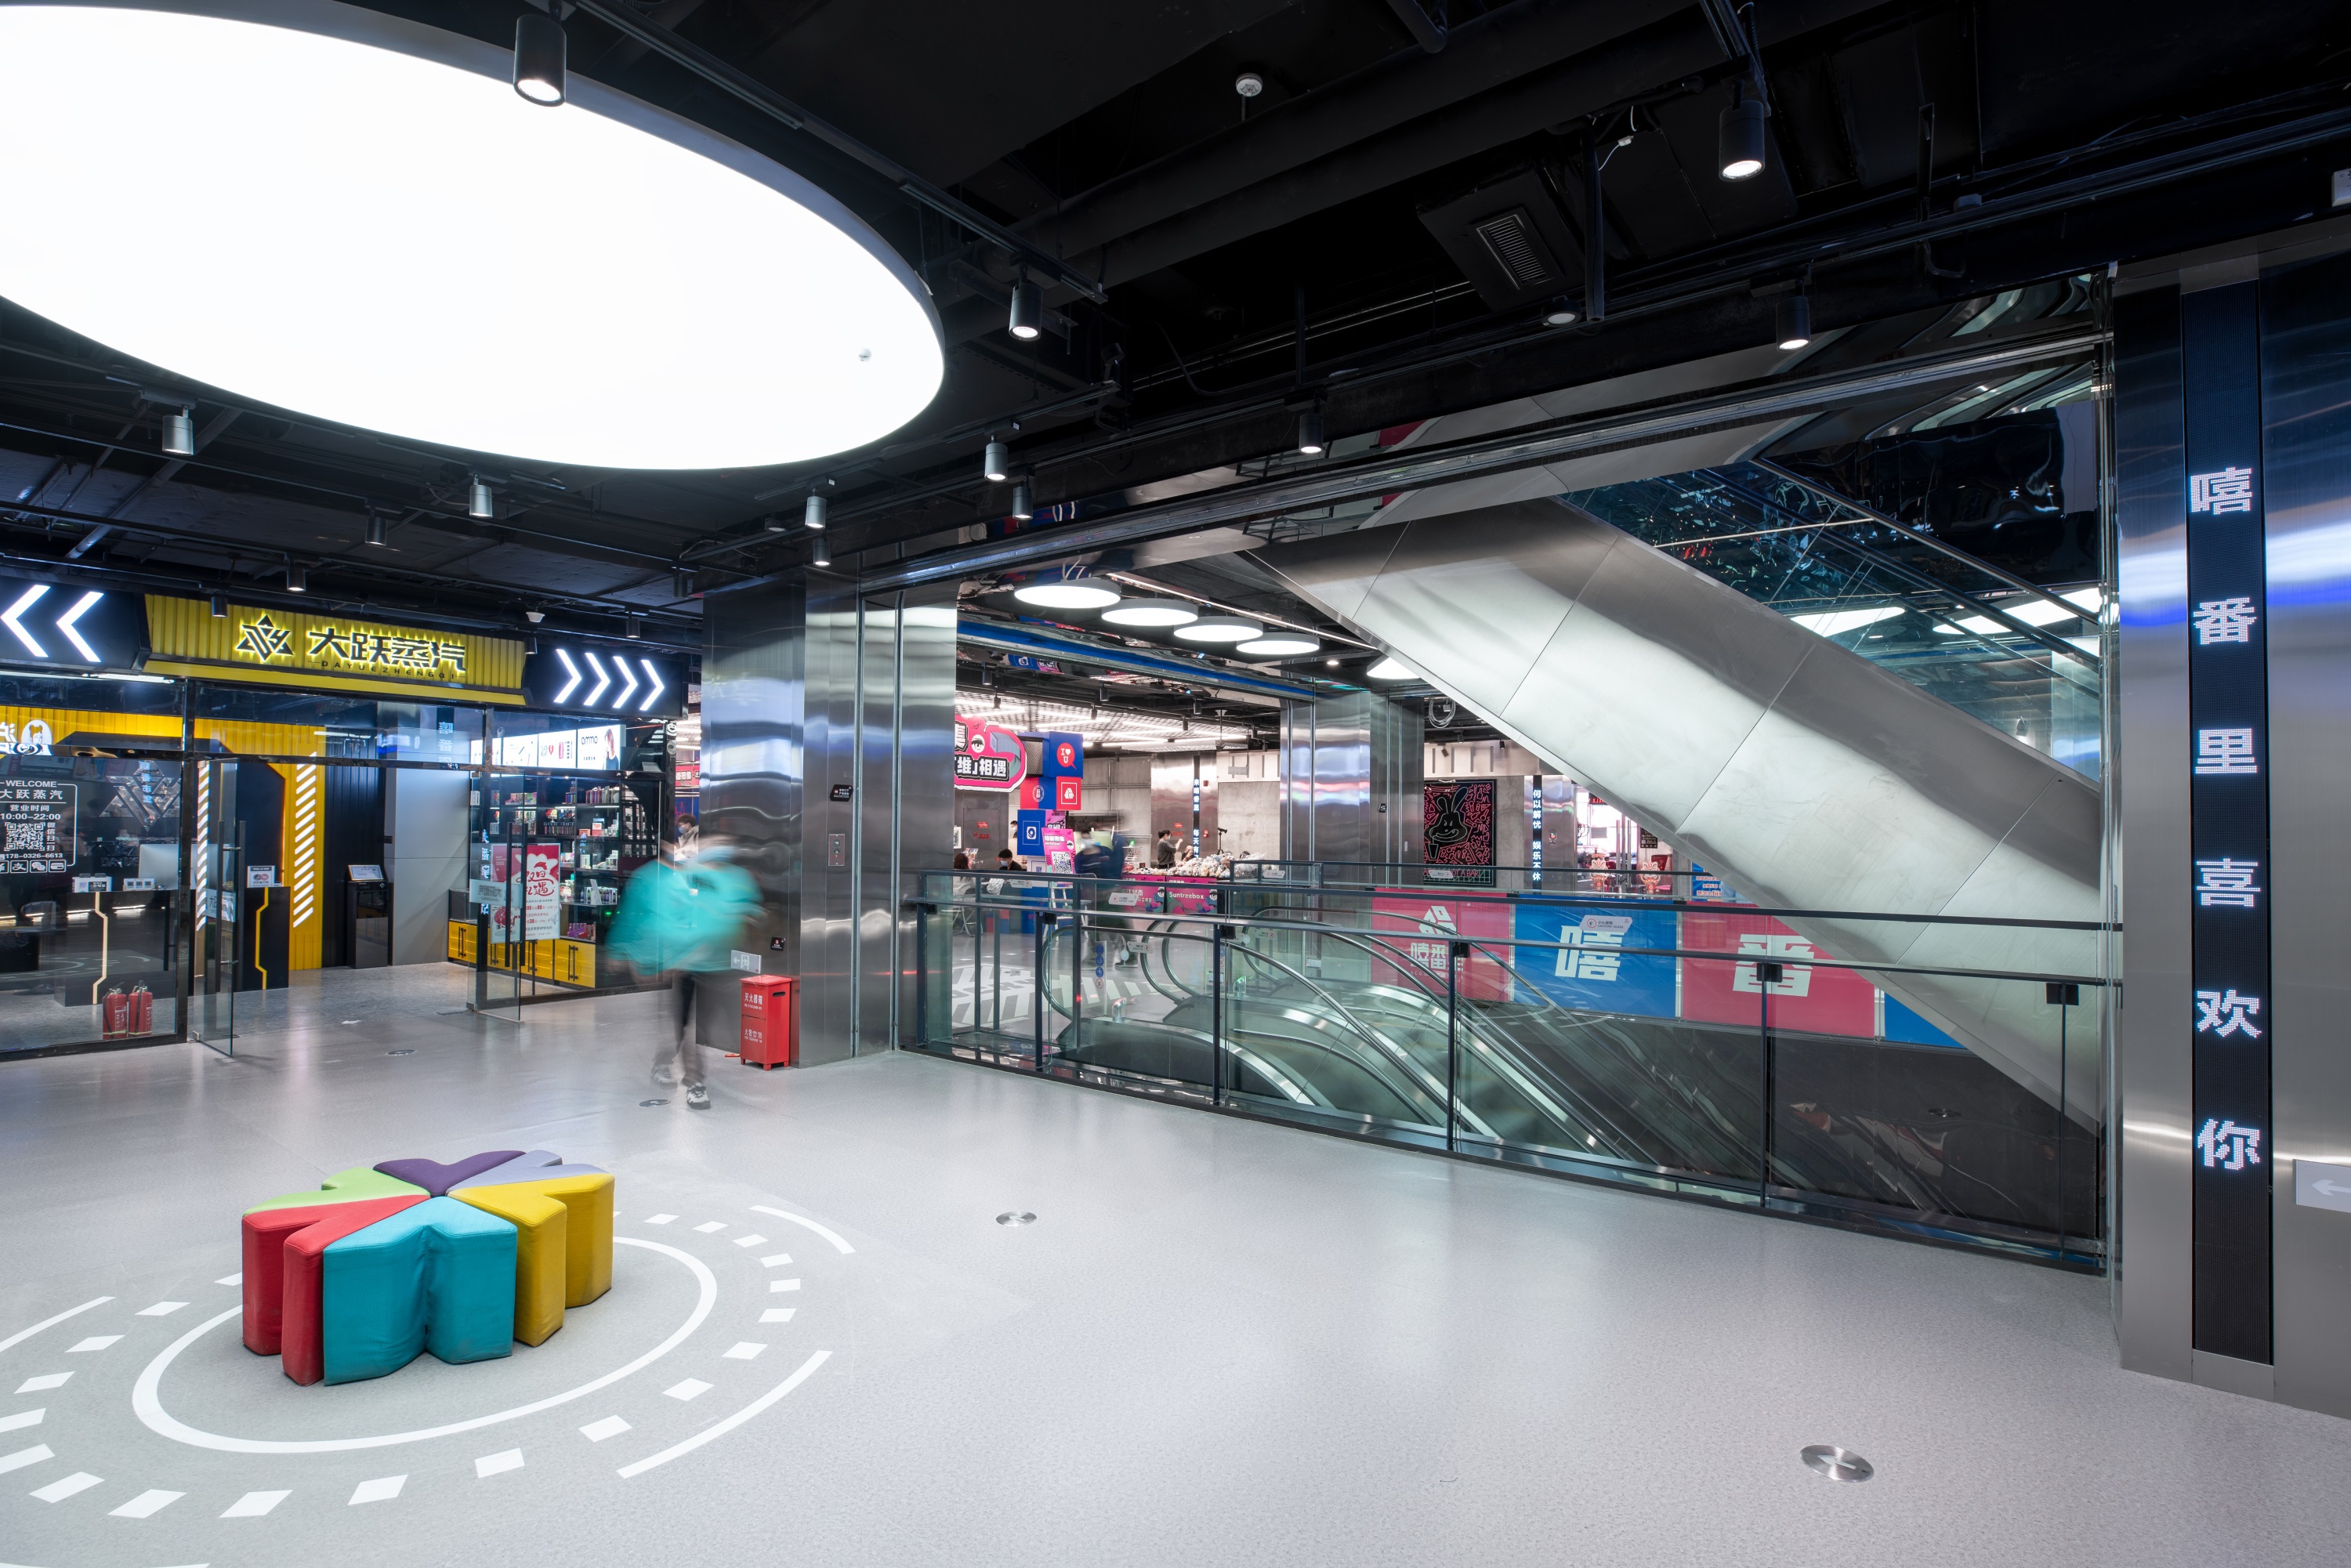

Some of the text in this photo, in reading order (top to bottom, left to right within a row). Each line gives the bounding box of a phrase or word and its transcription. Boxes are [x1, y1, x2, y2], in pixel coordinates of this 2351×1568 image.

[308, 628, 465, 672] 大跃蒸汽
[321, 661, 455, 679] DAYUEZHENGQI
[0, 788, 63, 800] 大跃蒸汽
[2190, 467, 2261, 1171] 嘻番里喜欢你
[47, 822, 56, 851] 微信扫一扫
[1533, 789, 1541, 882] 何以解忧 娱乐不休
[1168, 891, 1204, 900] Suntreebox
[1555, 925, 1815, 998] 嘻 番
[744, 992, 763, 1005] 灭火器箱
